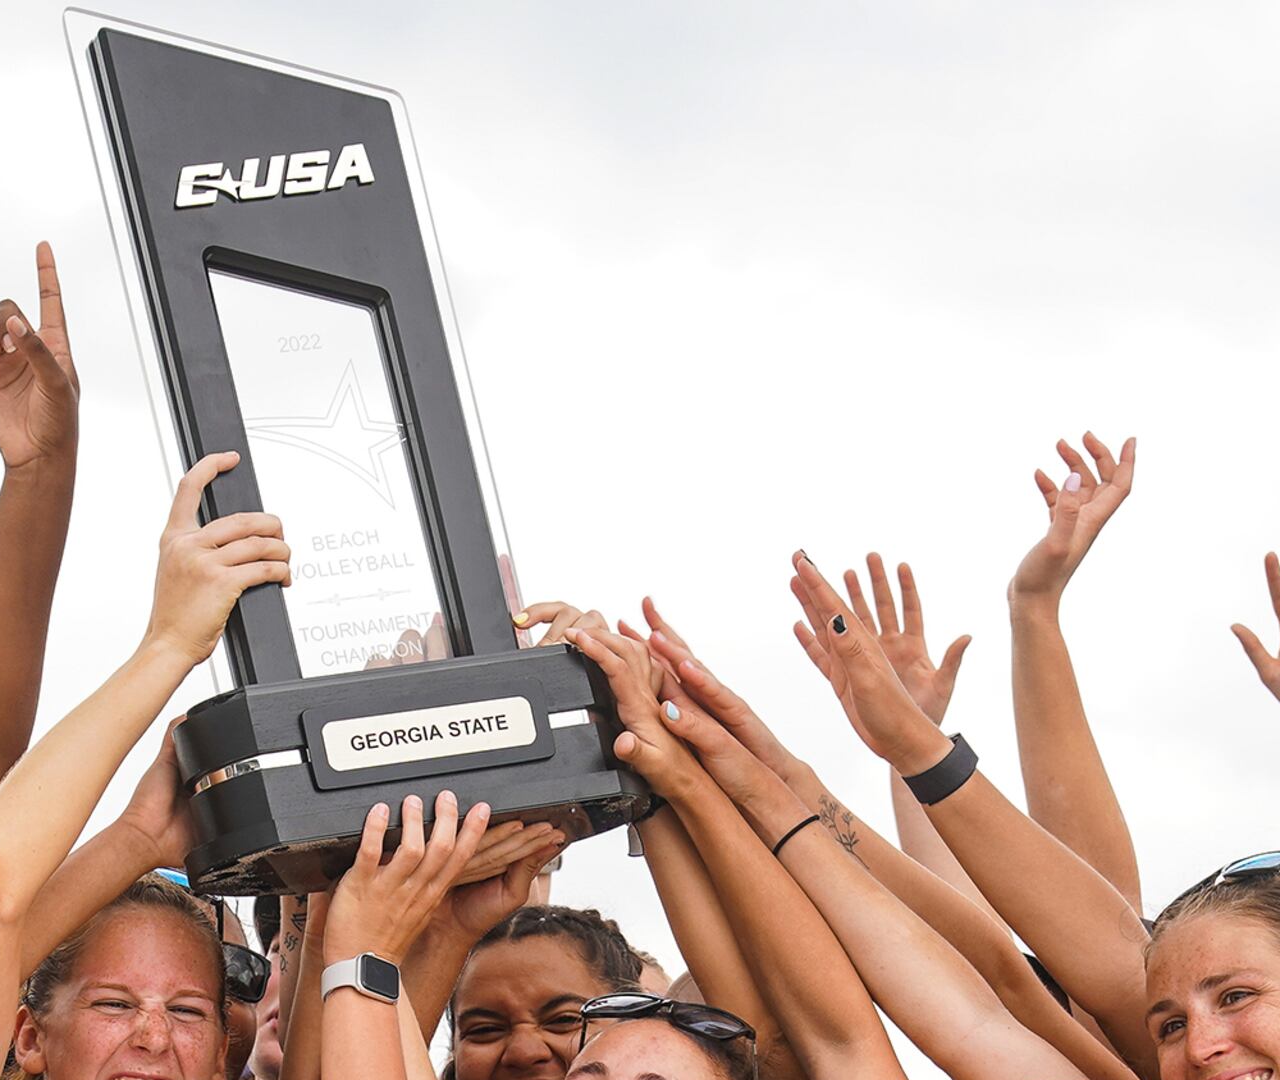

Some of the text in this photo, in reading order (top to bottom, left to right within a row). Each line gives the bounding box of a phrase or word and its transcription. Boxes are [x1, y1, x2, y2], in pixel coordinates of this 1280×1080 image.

[277, 333, 323, 354] 2022
[311, 528, 381, 553] BEACH
[290, 551, 415, 581] VOLLEYBALL
[298, 611, 431, 644] TOURNAMENT
[320, 638, 424, 668] CHAMPION
[349, 713, 510, 752] GEORGIA STATE
